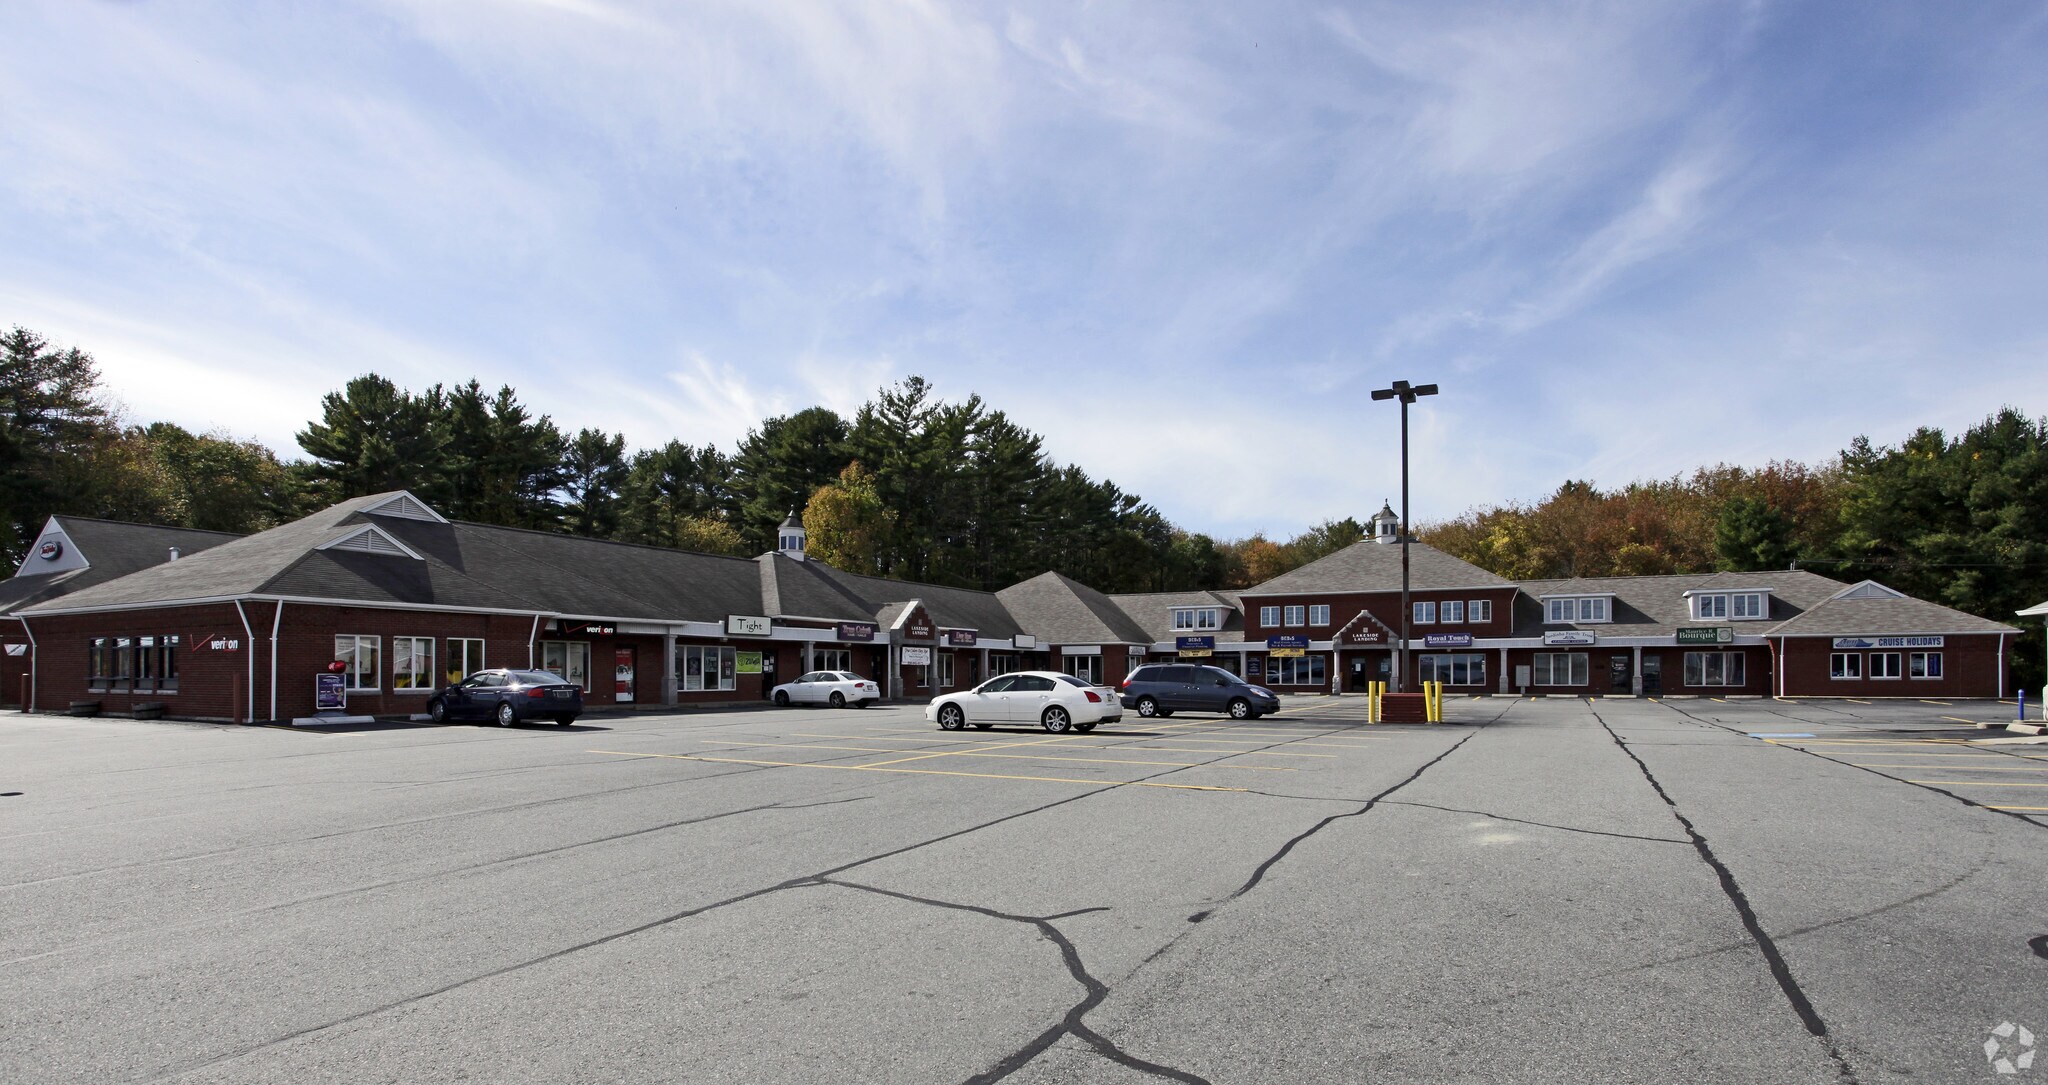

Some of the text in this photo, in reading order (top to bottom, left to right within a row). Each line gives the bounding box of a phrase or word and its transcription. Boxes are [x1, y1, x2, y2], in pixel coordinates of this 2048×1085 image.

[586, 625, 614, 635] verizon
[737, 618, 762, 632] Tight
[1679, 632, 1716, 640] Bourque
[211, 637, 239, 651] verizon
[1878, 637, 1942, 647] CRUISE HOLIDAYS
